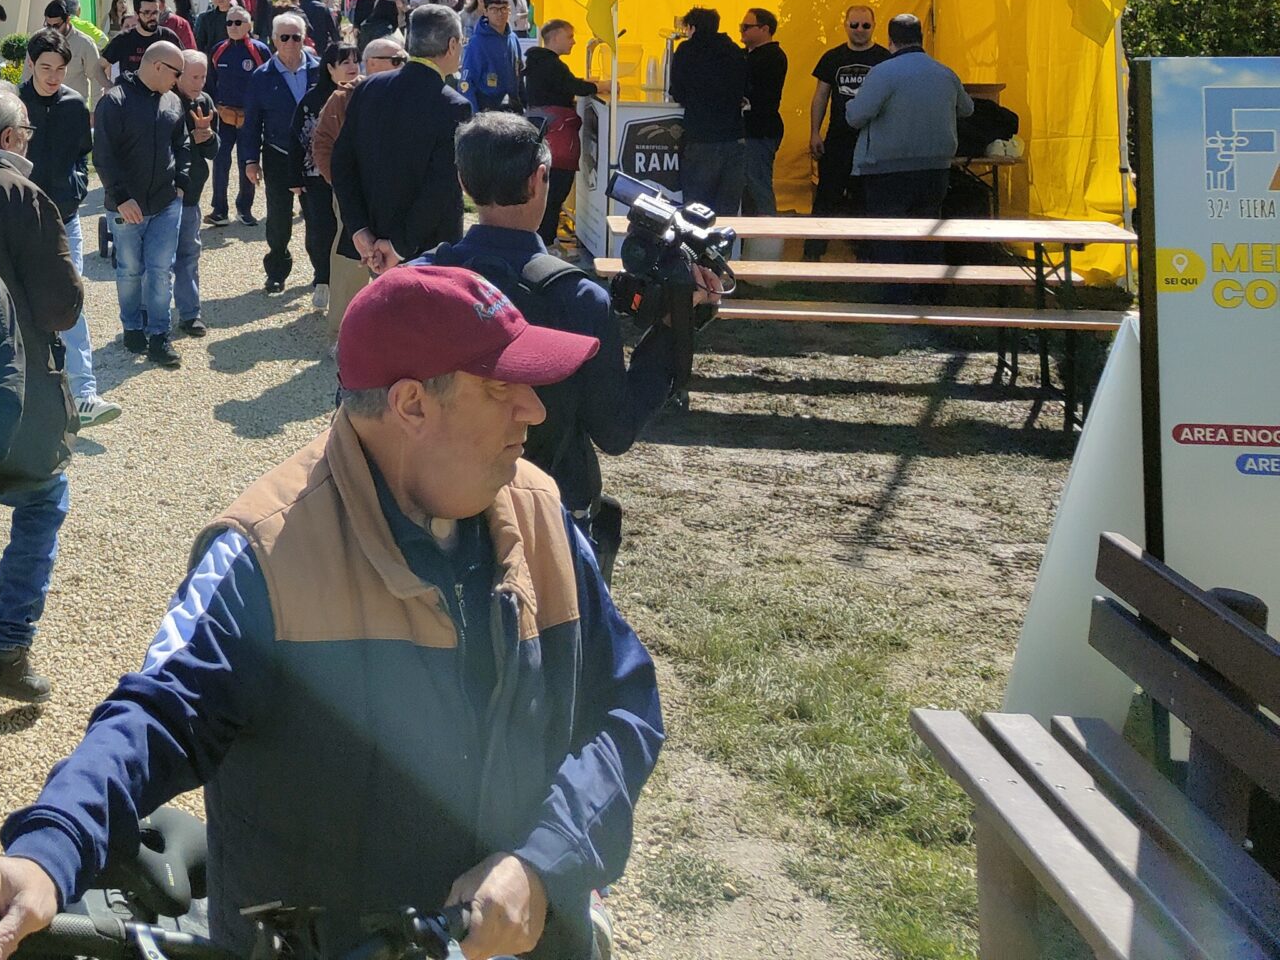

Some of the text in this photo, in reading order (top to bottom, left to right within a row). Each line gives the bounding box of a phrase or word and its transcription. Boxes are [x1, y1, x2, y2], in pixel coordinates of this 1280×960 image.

[635, 152, 680, 173] RAM
[1240, 199, 1276, 218] FIERA
[1211, 243, 1280, 272] ME
[1164, 277, 1198, 287] SEI QUI
[1211, 278, 1280, 309] CO
[1181, 427, 1228, 442] AREA
[1245, 458, 1280, 472] ARE
